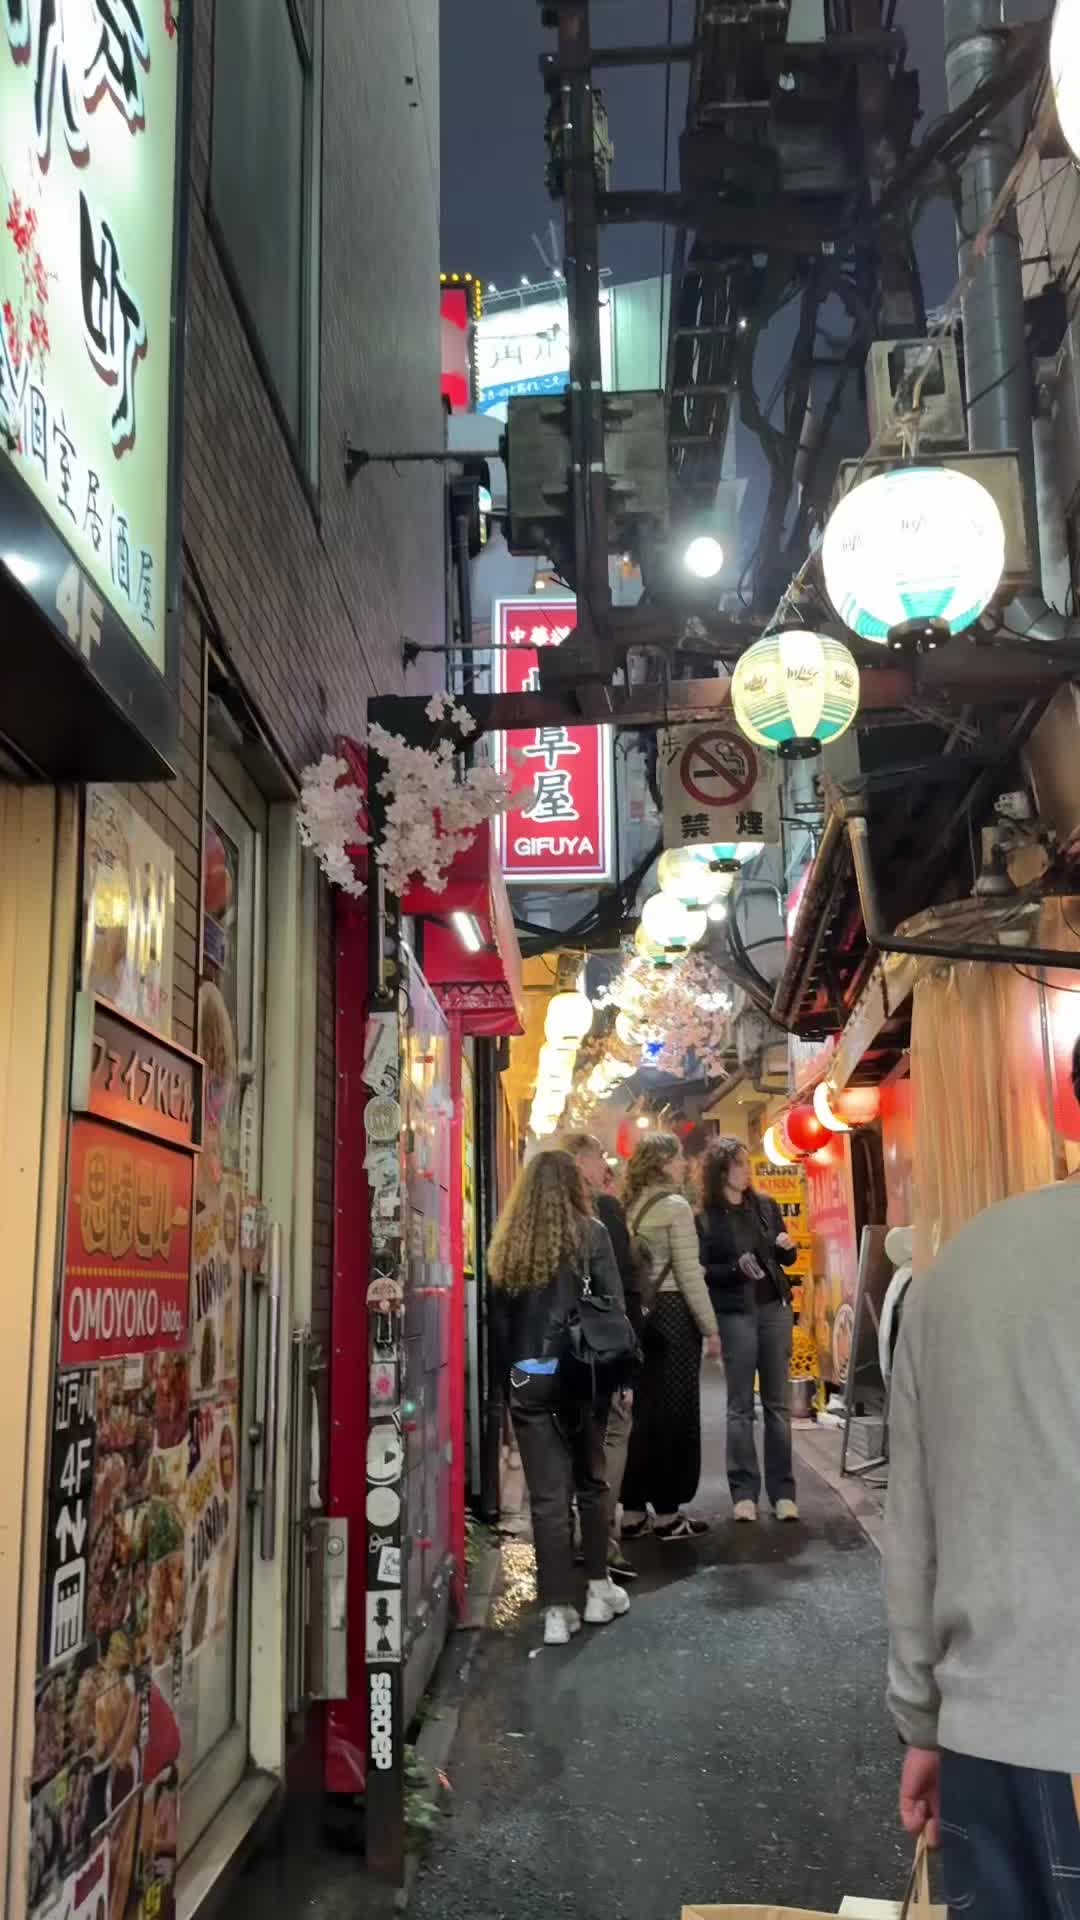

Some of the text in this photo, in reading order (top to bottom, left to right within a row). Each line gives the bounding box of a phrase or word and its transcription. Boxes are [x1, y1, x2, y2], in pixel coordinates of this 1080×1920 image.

[56, 564, 105, 661] 4F
[522, 667, 580, 822] 阜屋
[514, 836, 594, 857] GIFUYA
[681, 811, 764, 839] 禁煙
[68, 1287, 158, 1342] OMOYOKO
[60, 1437, 92, 1497] 4F
